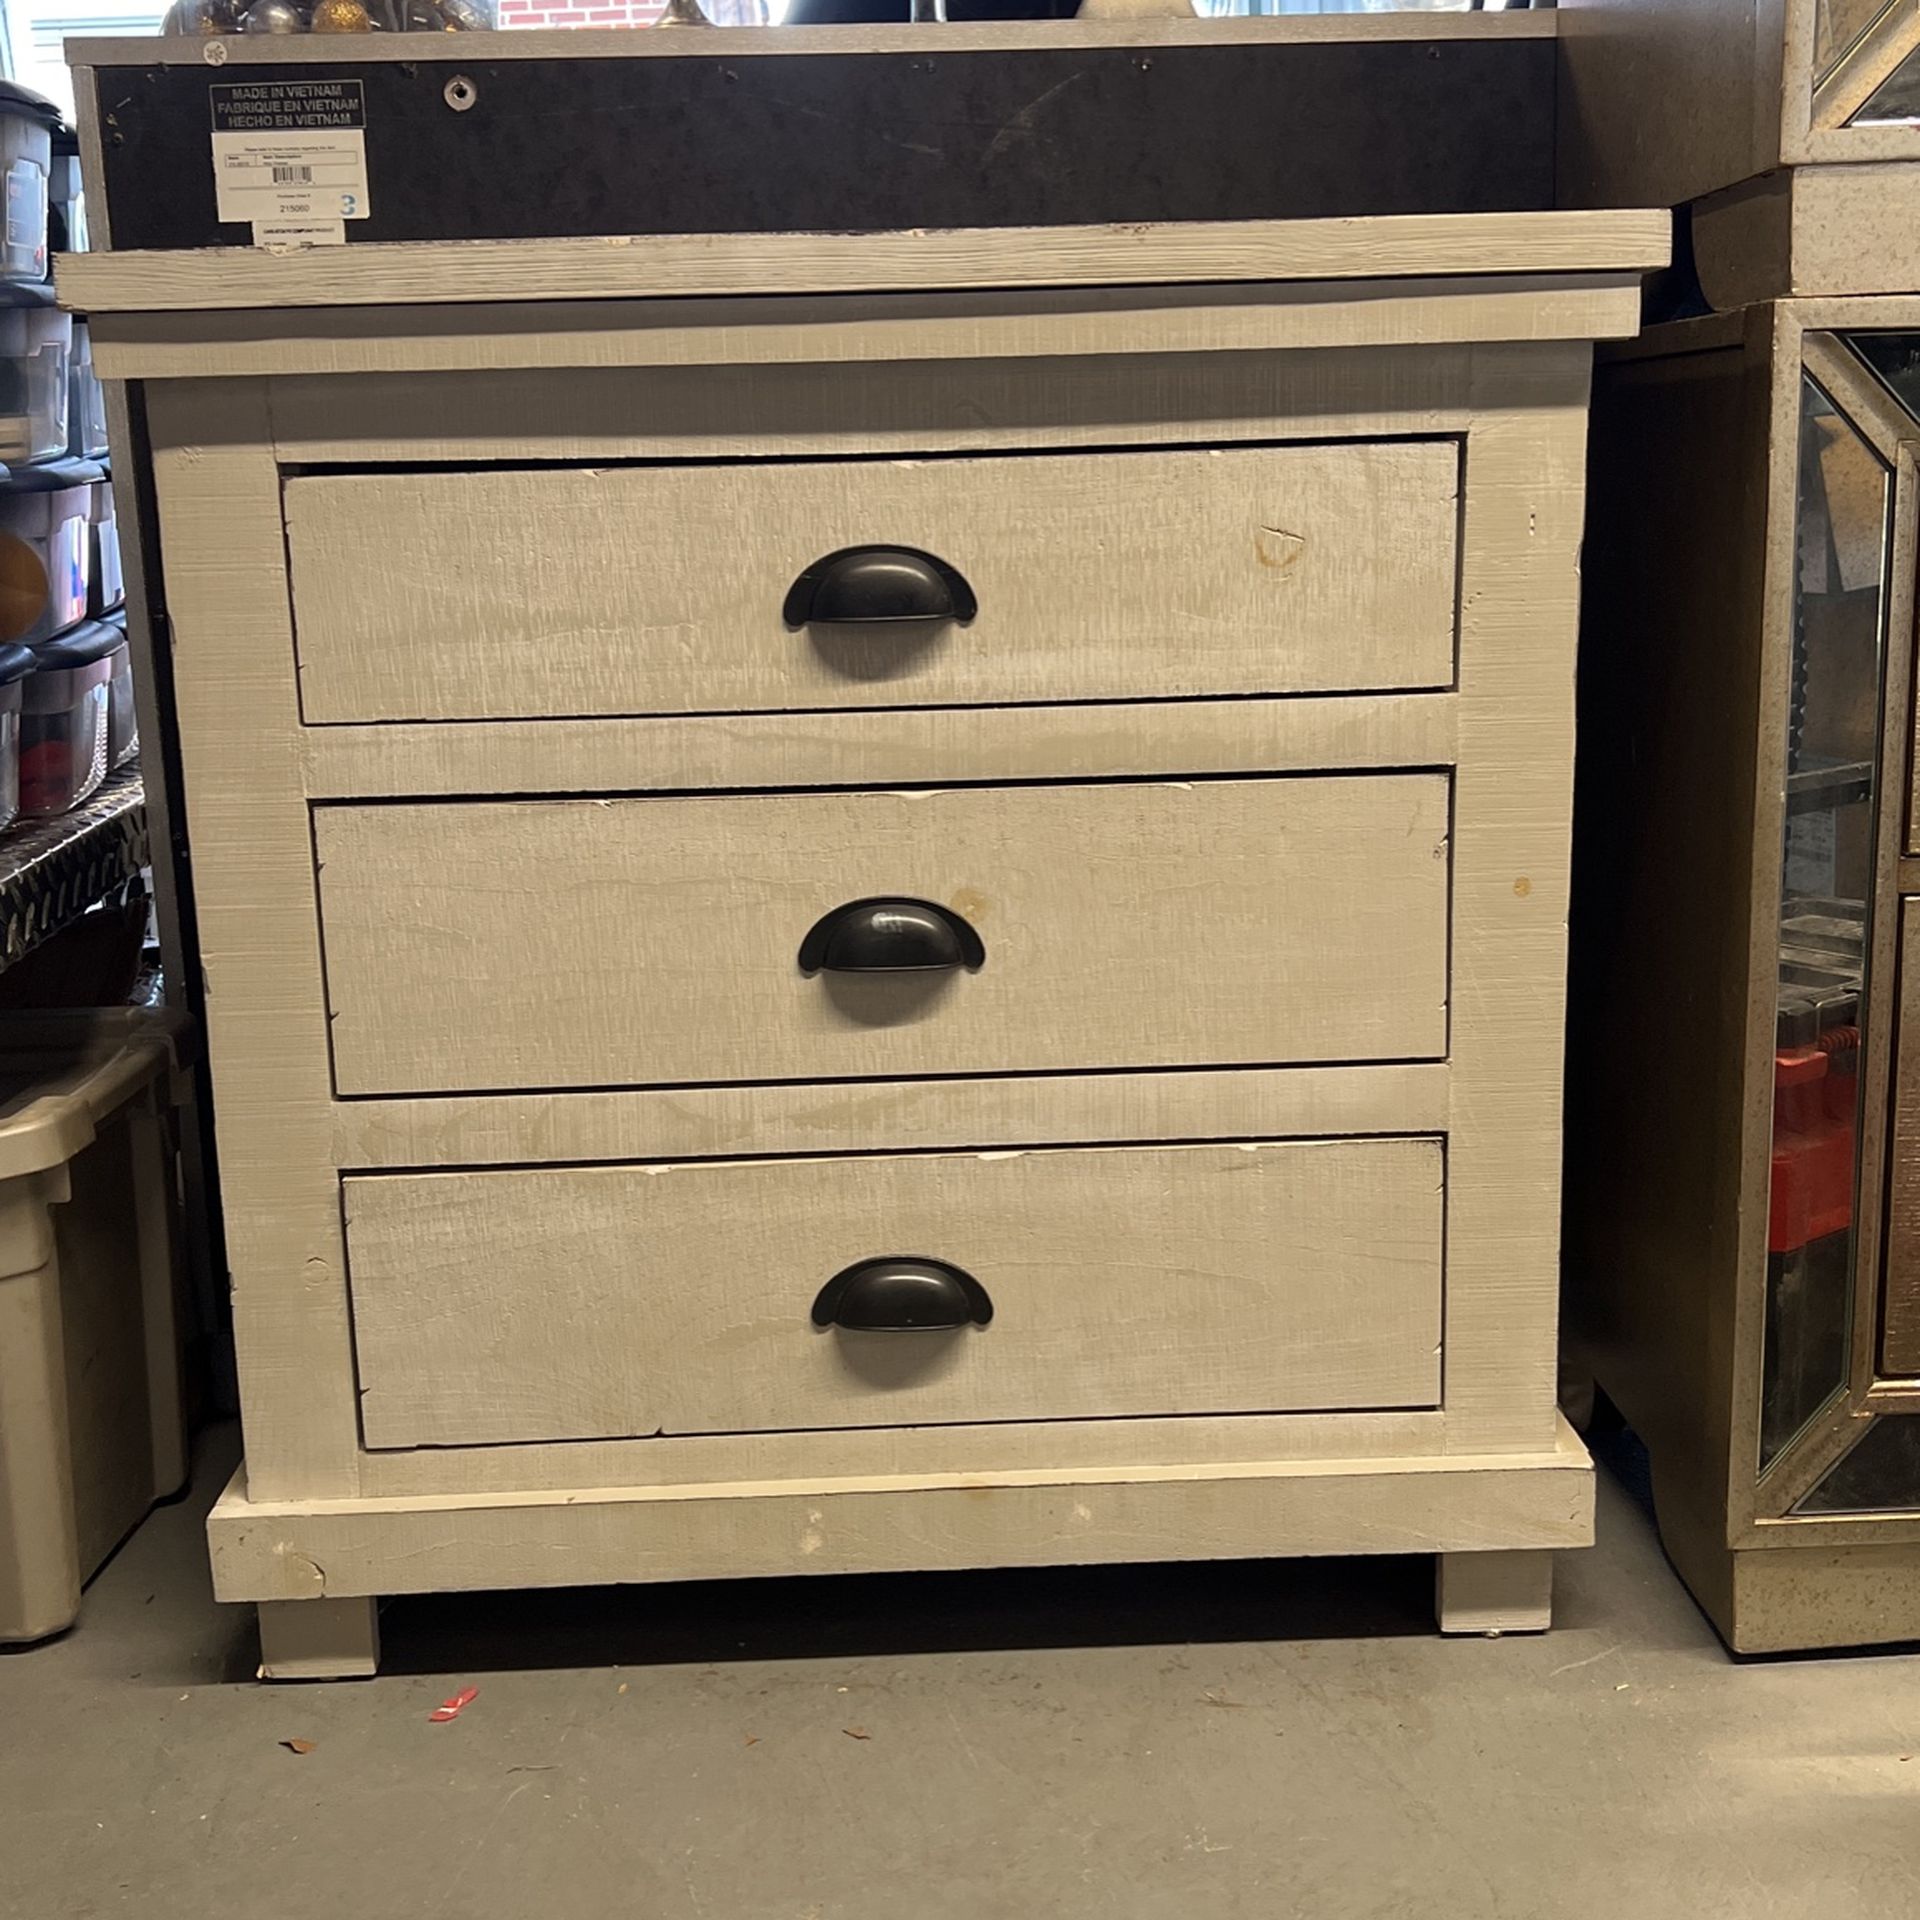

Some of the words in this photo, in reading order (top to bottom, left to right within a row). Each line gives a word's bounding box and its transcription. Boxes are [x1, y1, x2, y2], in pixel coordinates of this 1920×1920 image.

[232, 87, 269, 99] MADE
[271, 86, 284, 98] IN
[285, 84, 342, 98] VIETNAM
[218, 101, 281, 114] FABRIQUE
[283, 100, 302, 112] EN
[304, 98, 359, 111] VIETNAM
[228, 115, 273, 128] HECHO
[275, 114, 294, 127] EN
[296, 112, 351, 126] VIETNAM
